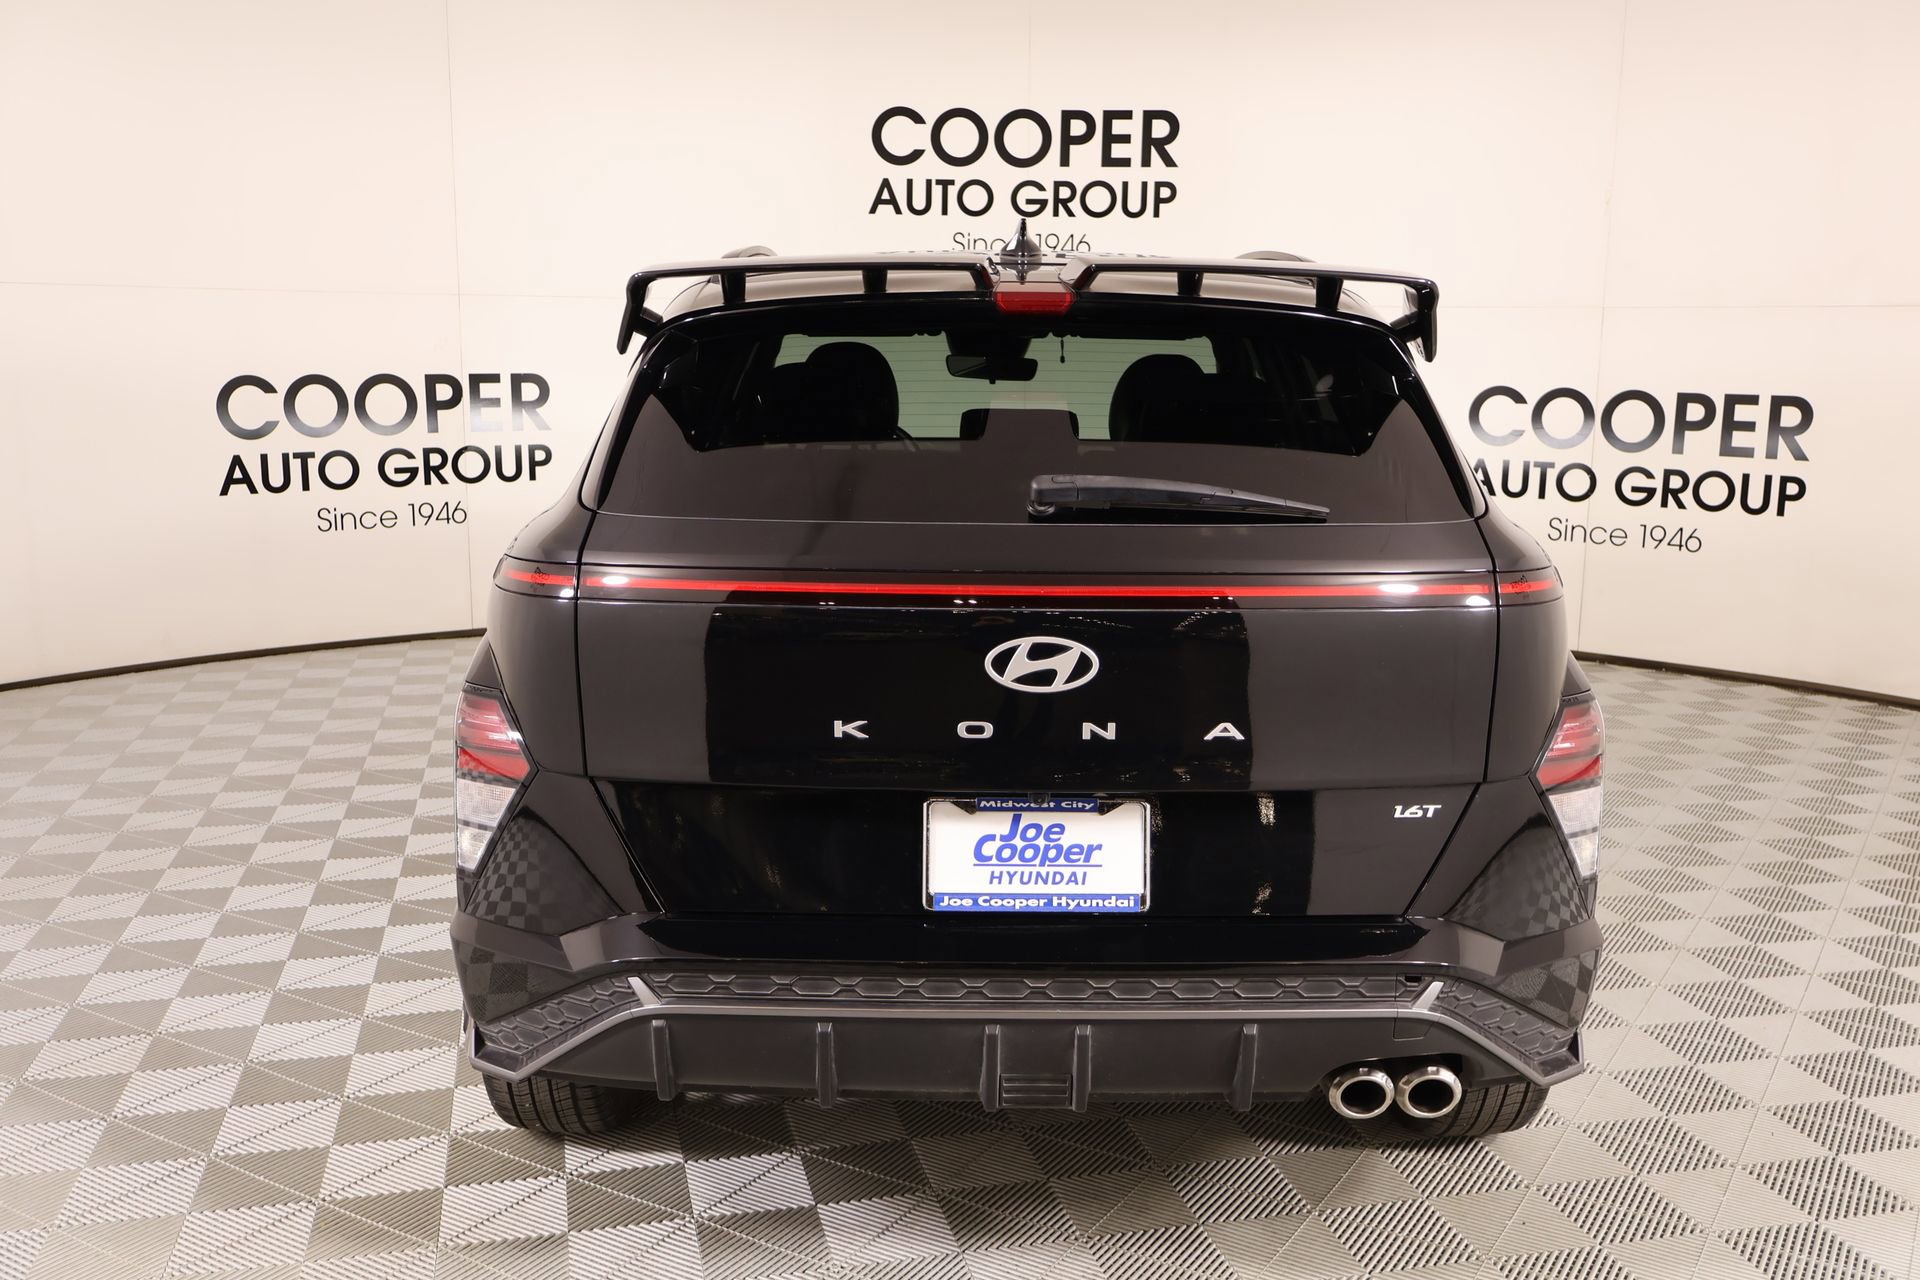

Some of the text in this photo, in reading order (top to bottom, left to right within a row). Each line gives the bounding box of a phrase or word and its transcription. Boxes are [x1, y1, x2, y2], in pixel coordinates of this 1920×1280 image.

[871, 105, 1180, 168] COOPER
[868, 177, 1177, 218] AUTO GROUP
[216, 373, 552, 440] COOPER
[1468, 385, 1814, 462] COOPER
[219, 444, 552, 496] AUTO GROUP
[1473, 458, 1807, 517] AUTO GROUP
[317, 500, 468, 533] Since 1946
[1547, 517, 1703, 553] Since 1946
[833, 720, 1245, 741] KONA
[1060, 801, 1095, 809] City
[1000, 813, 1066, 843] Joe
[973, 834, 1103, 867] Cooper
[989, 871, 1087, 886] HYUNDAI
[940, 896, 1135, 909] Joe Cooper Hyundai
